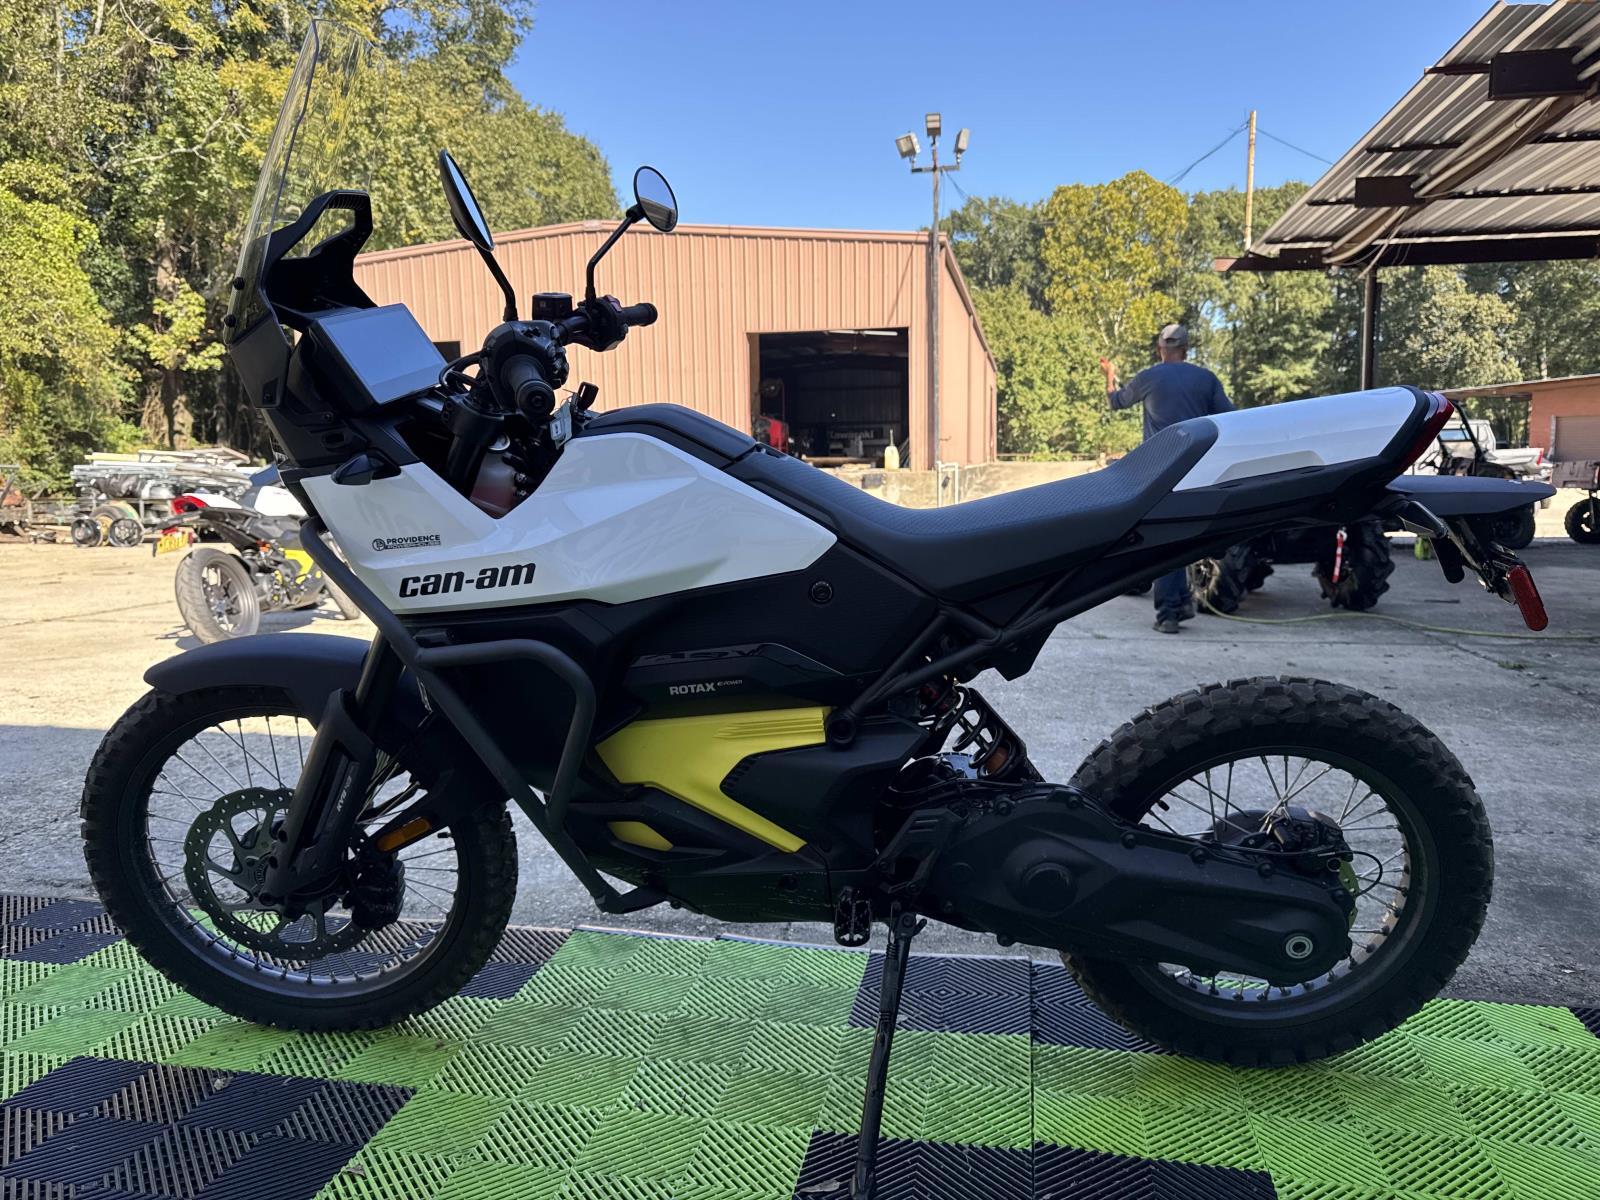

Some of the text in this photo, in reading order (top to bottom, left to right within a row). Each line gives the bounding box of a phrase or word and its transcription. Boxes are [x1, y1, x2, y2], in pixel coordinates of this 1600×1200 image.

[386, 534, 441, 545] PROVIDENCE
[398, 562, 536, 598] can-am
[669, 681, 717, 696] ROTAX
